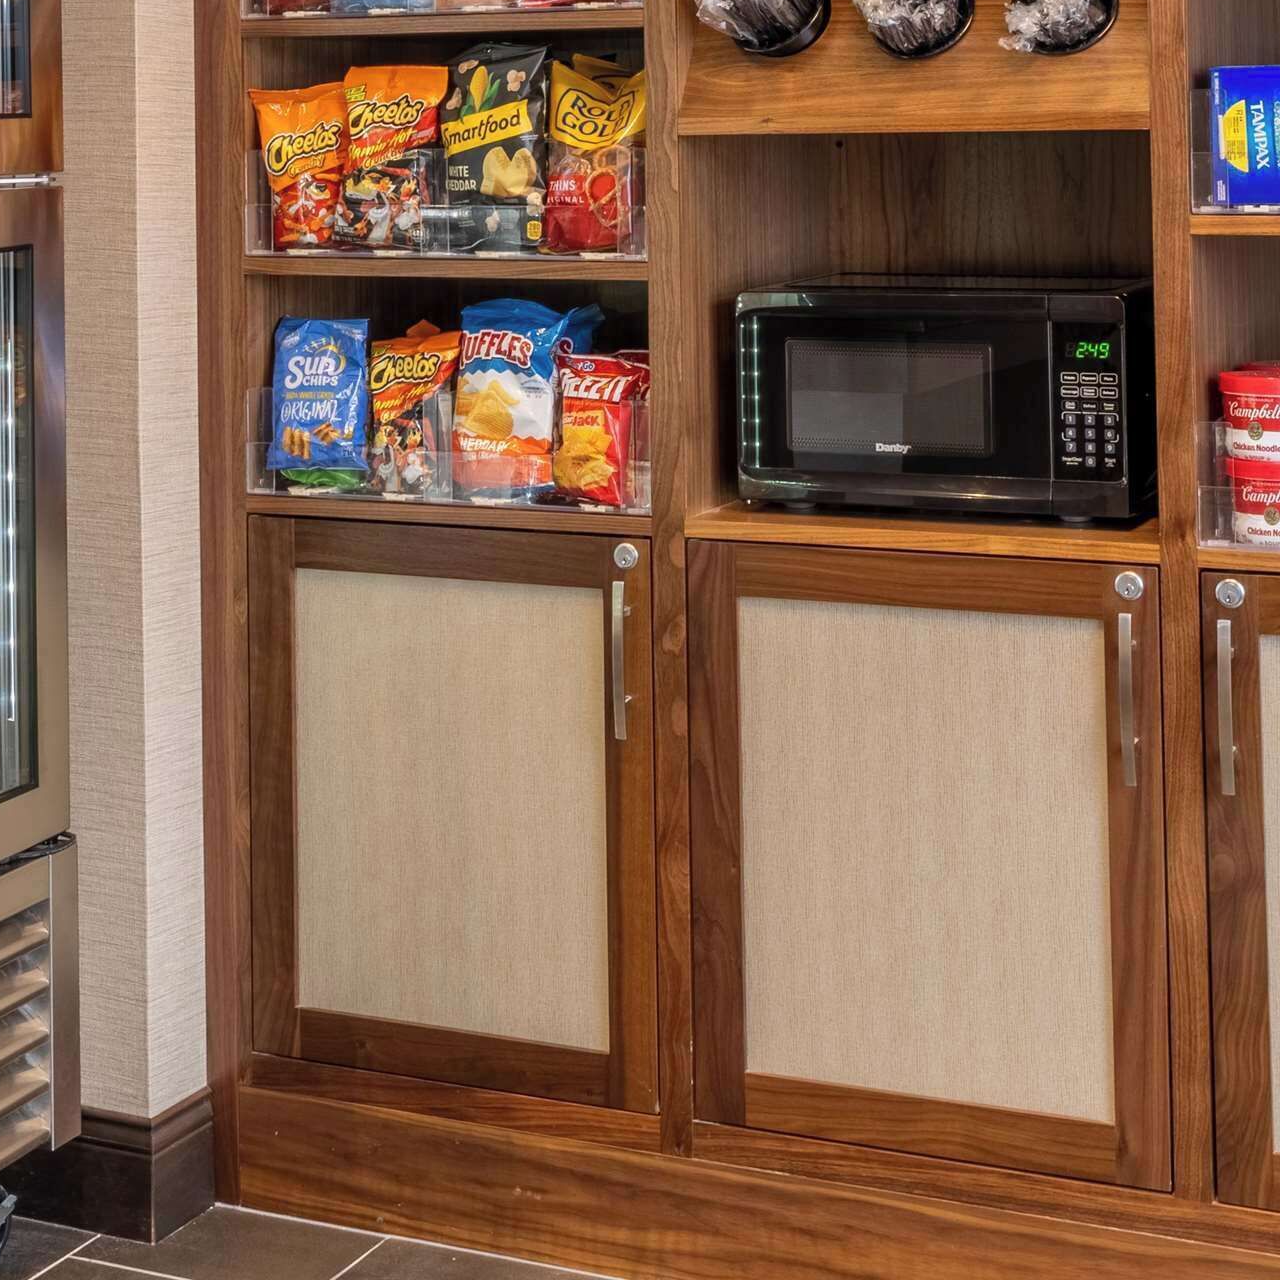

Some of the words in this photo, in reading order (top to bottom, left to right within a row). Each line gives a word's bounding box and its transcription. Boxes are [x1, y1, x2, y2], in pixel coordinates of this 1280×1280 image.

[348, 96, 424, 133] Cheetos
[443, 112, 522, 146] Smartfood
[267, 122, 342, 171] Cheetos
[1251, 100, 1270, 169] TAMPAX
[549, 180, 576, 192] THINS
[284, 355, 336, 389] Sun
[302, 375, 338, 387] CHIPS
[371, 353, 440, 390] Cheetos
[875, 442, 910, 454] Danby
[1232, 442, 1258, 453] Chicken
